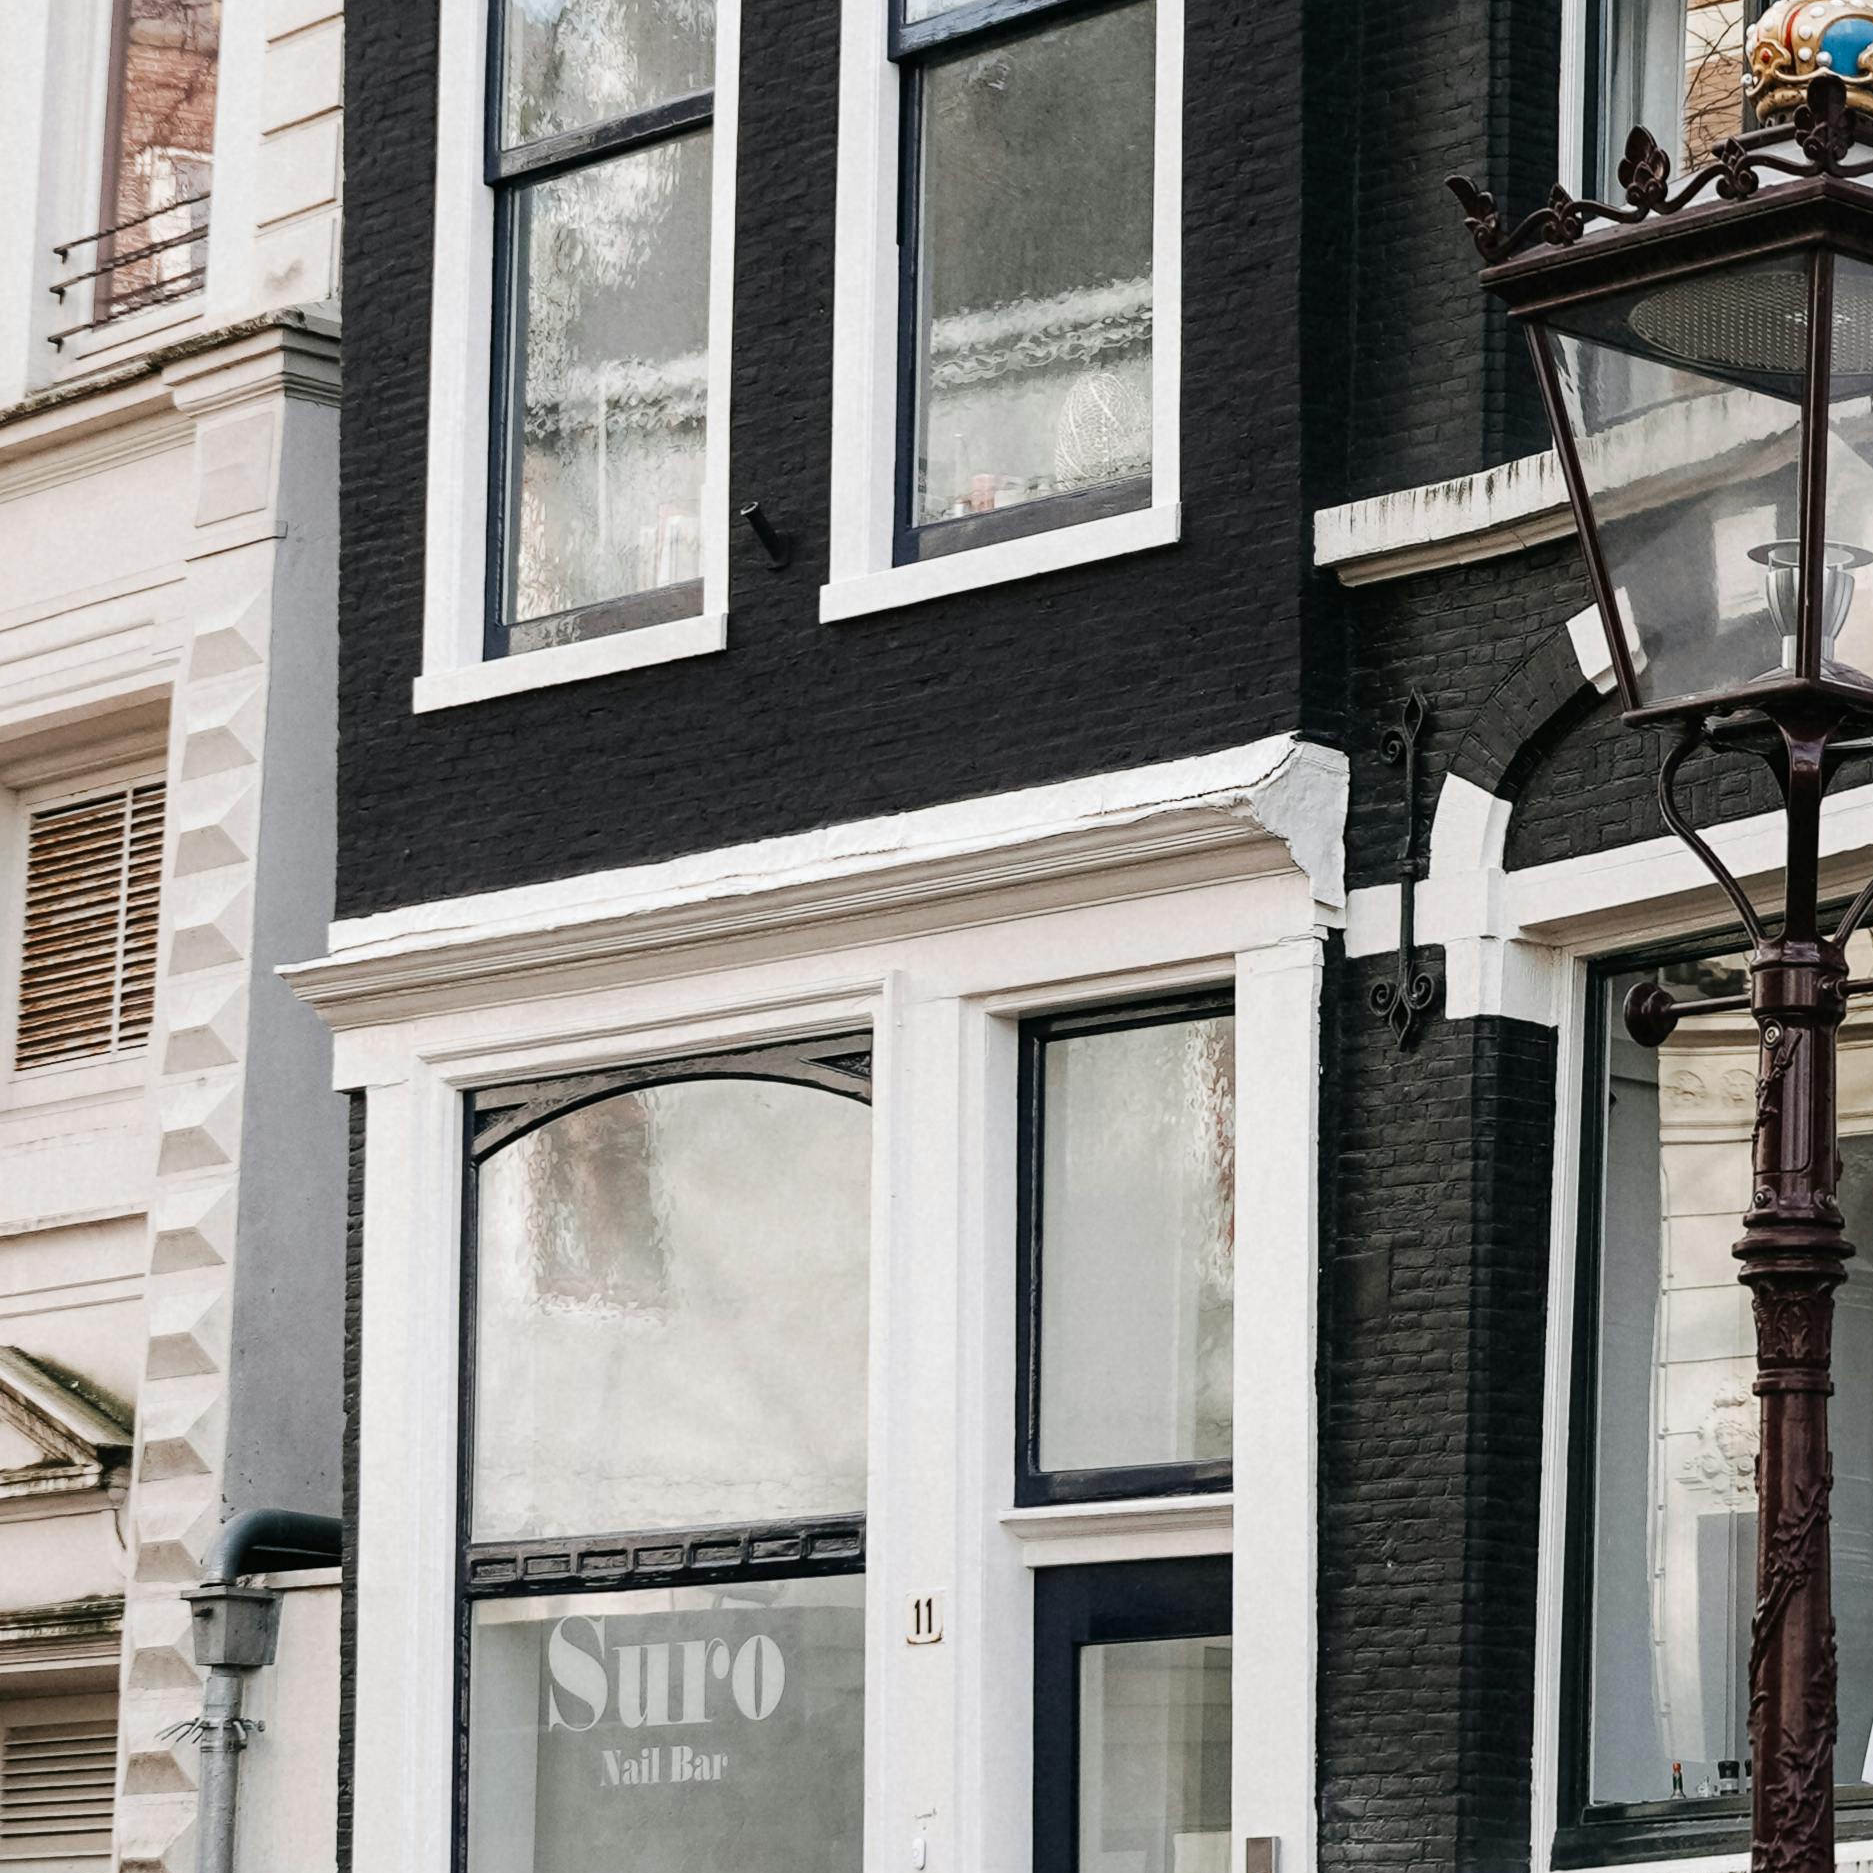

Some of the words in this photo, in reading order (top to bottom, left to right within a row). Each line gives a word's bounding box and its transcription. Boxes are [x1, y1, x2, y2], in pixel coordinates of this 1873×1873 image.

[914, 1598, 934, 1635] 11
[548, 1615, 786, 1732] Suro
[600, 1746, 659, 1787] Nail
[671, 1745, 729, 1783] Bar
